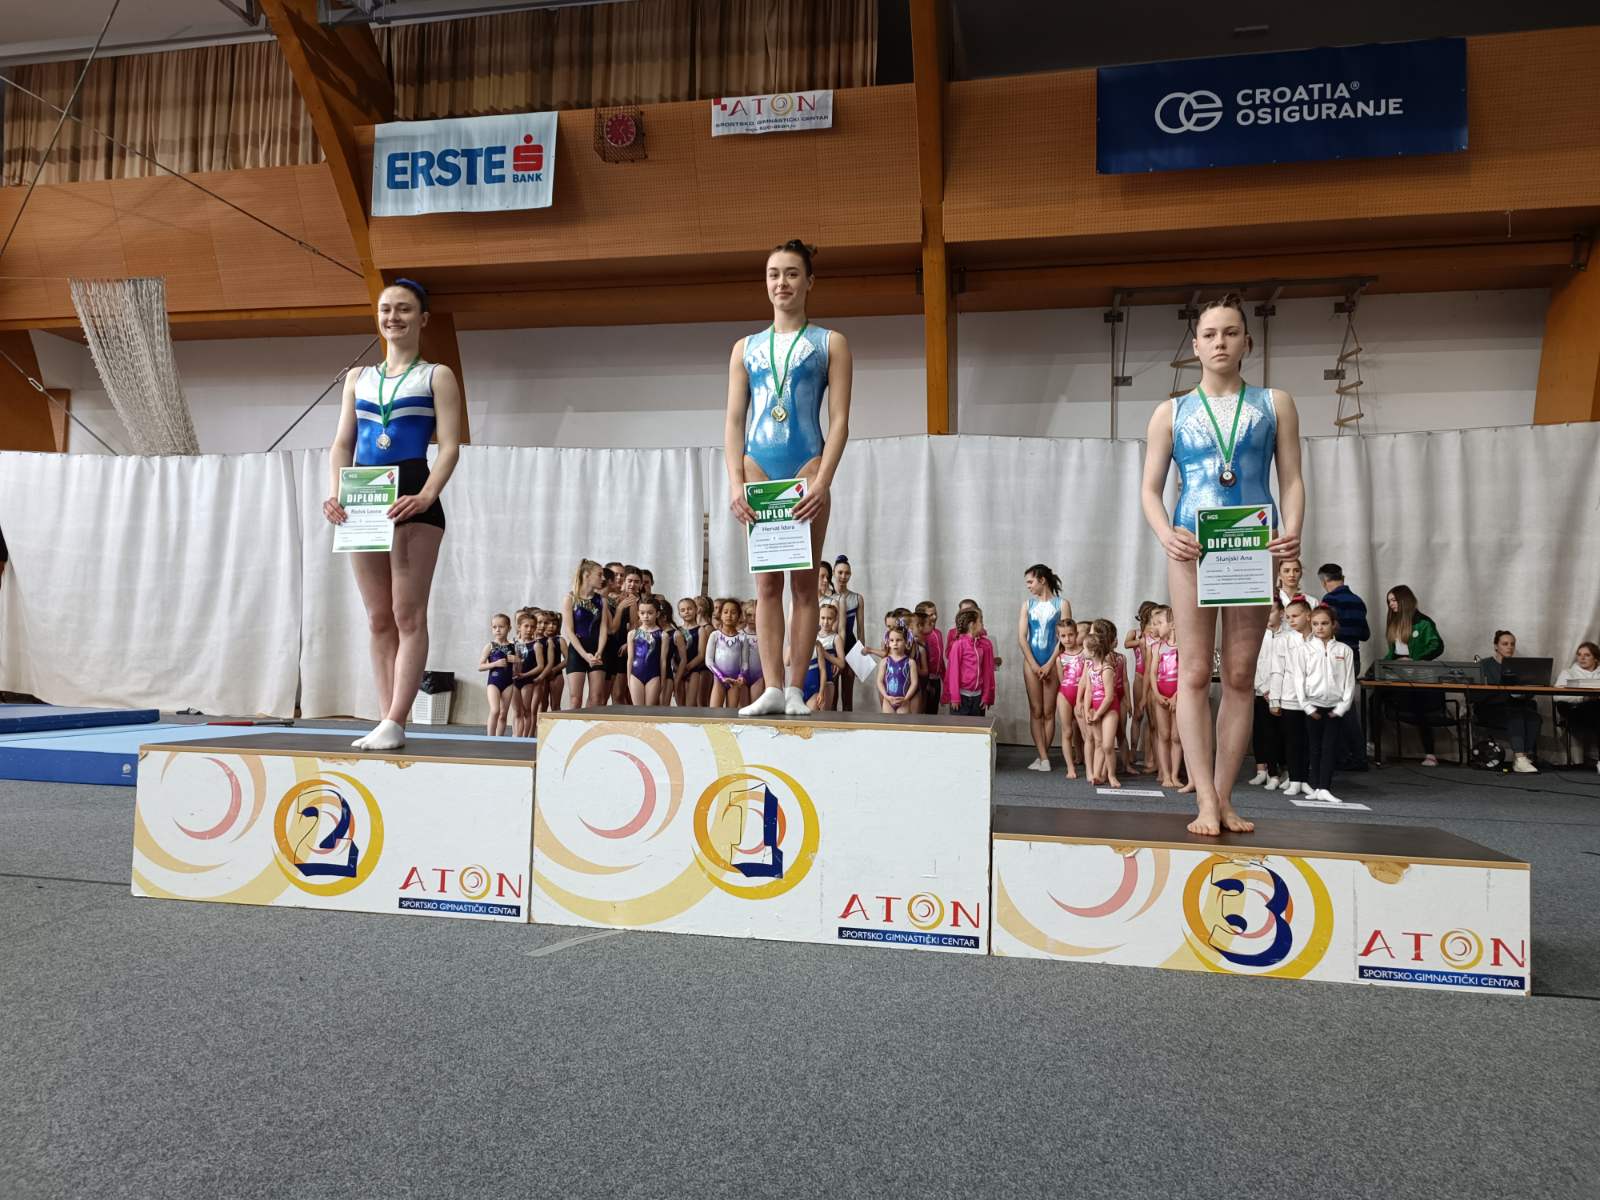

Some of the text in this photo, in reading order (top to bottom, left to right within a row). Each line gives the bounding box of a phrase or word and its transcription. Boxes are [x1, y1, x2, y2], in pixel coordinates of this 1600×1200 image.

[728, 93, 817, 117] ATON
[1236, 98, 1404, 126] OSIGURANJE
[386, 146, 506, 190] ERSTE
[512, 173, 543, 183] BANK
[346, 492, 389, 503] DIPLOMU
[755, 507, 793, 520] DIPLOM
[1207, 536, 1261, 549] DIPLOMU
[294, 789, 359, 878] 2
[729, 783, 783, 879] 1
[399, 864, 523, 900] ATON
[401, 900, 518, 916] SPORTSKO GIMNASTIČKI CENTAR
[838, 891, 980, 931] ATON
[1208, 861, 1293, 967] 3
[842, 930, 976, 948] SPORTSKO GIMNASTIČKI CENTAR
[1358, 928, 1527, 970] ATON
[1363, 969, 1520, 988] SPORTSKO GIMNASTIČKI CENTAR
